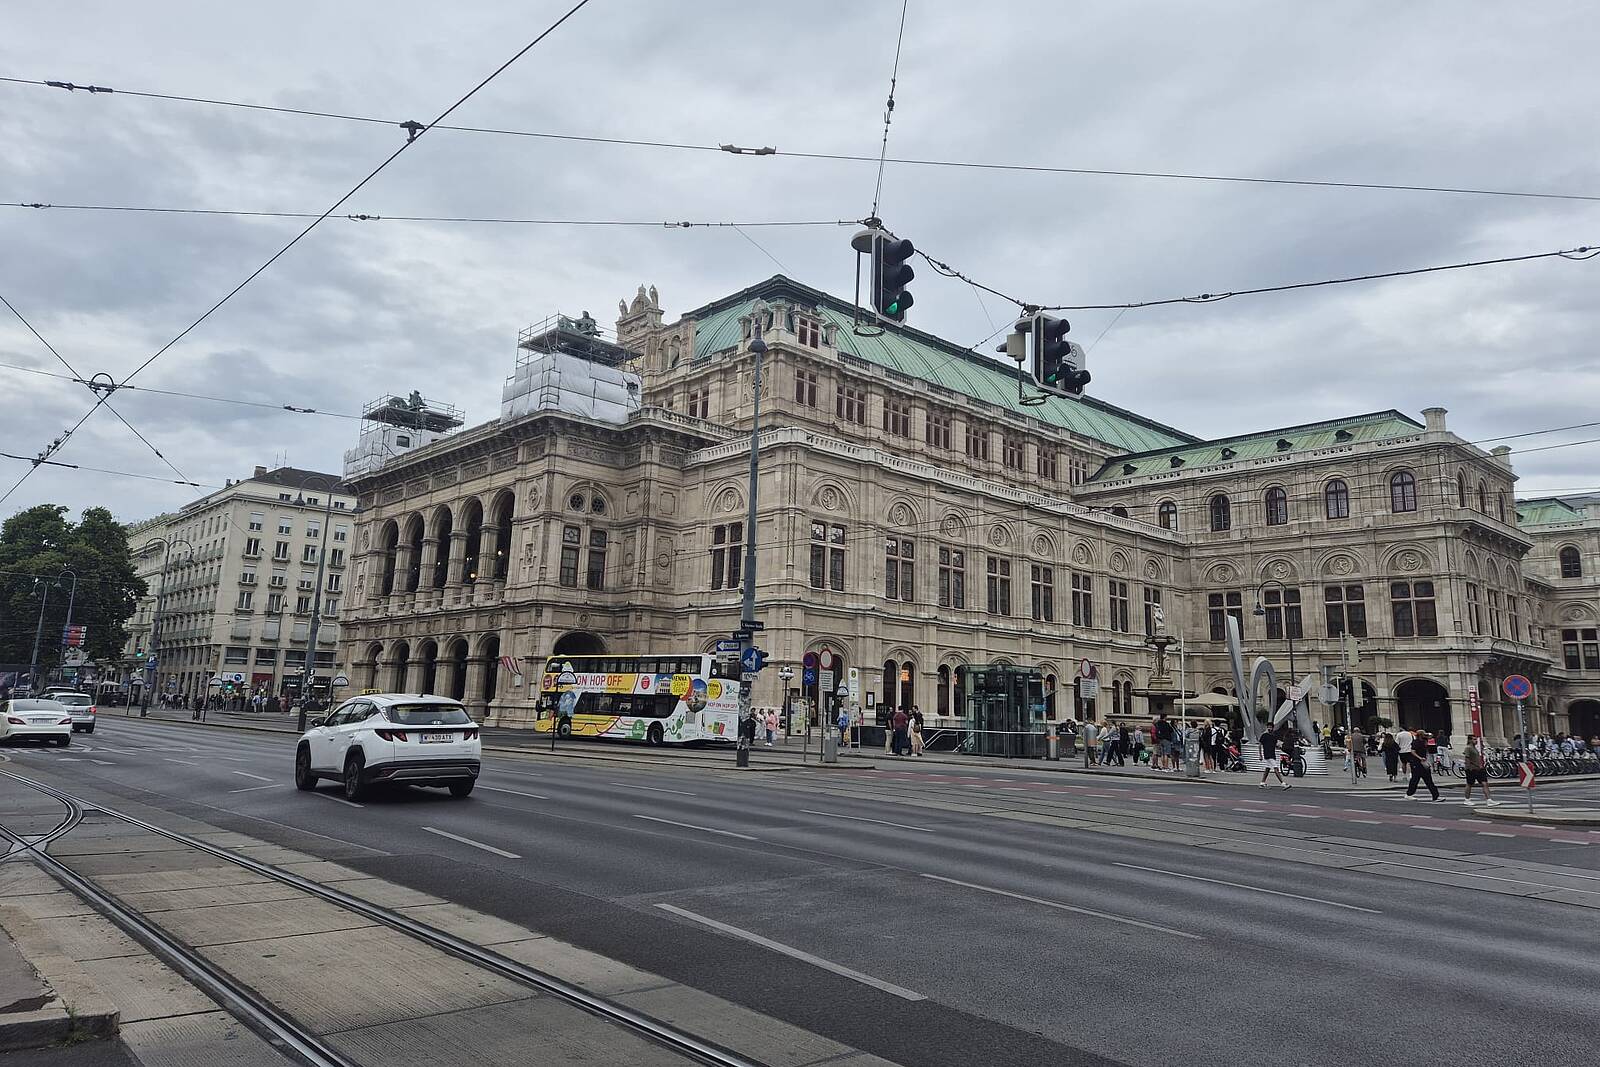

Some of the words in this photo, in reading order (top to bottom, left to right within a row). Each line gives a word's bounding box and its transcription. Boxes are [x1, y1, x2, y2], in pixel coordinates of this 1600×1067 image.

[577, 675, 587, 686] ON
[590, 675, 606, 686] HOP
[607, 675, 623, 687] OFF
